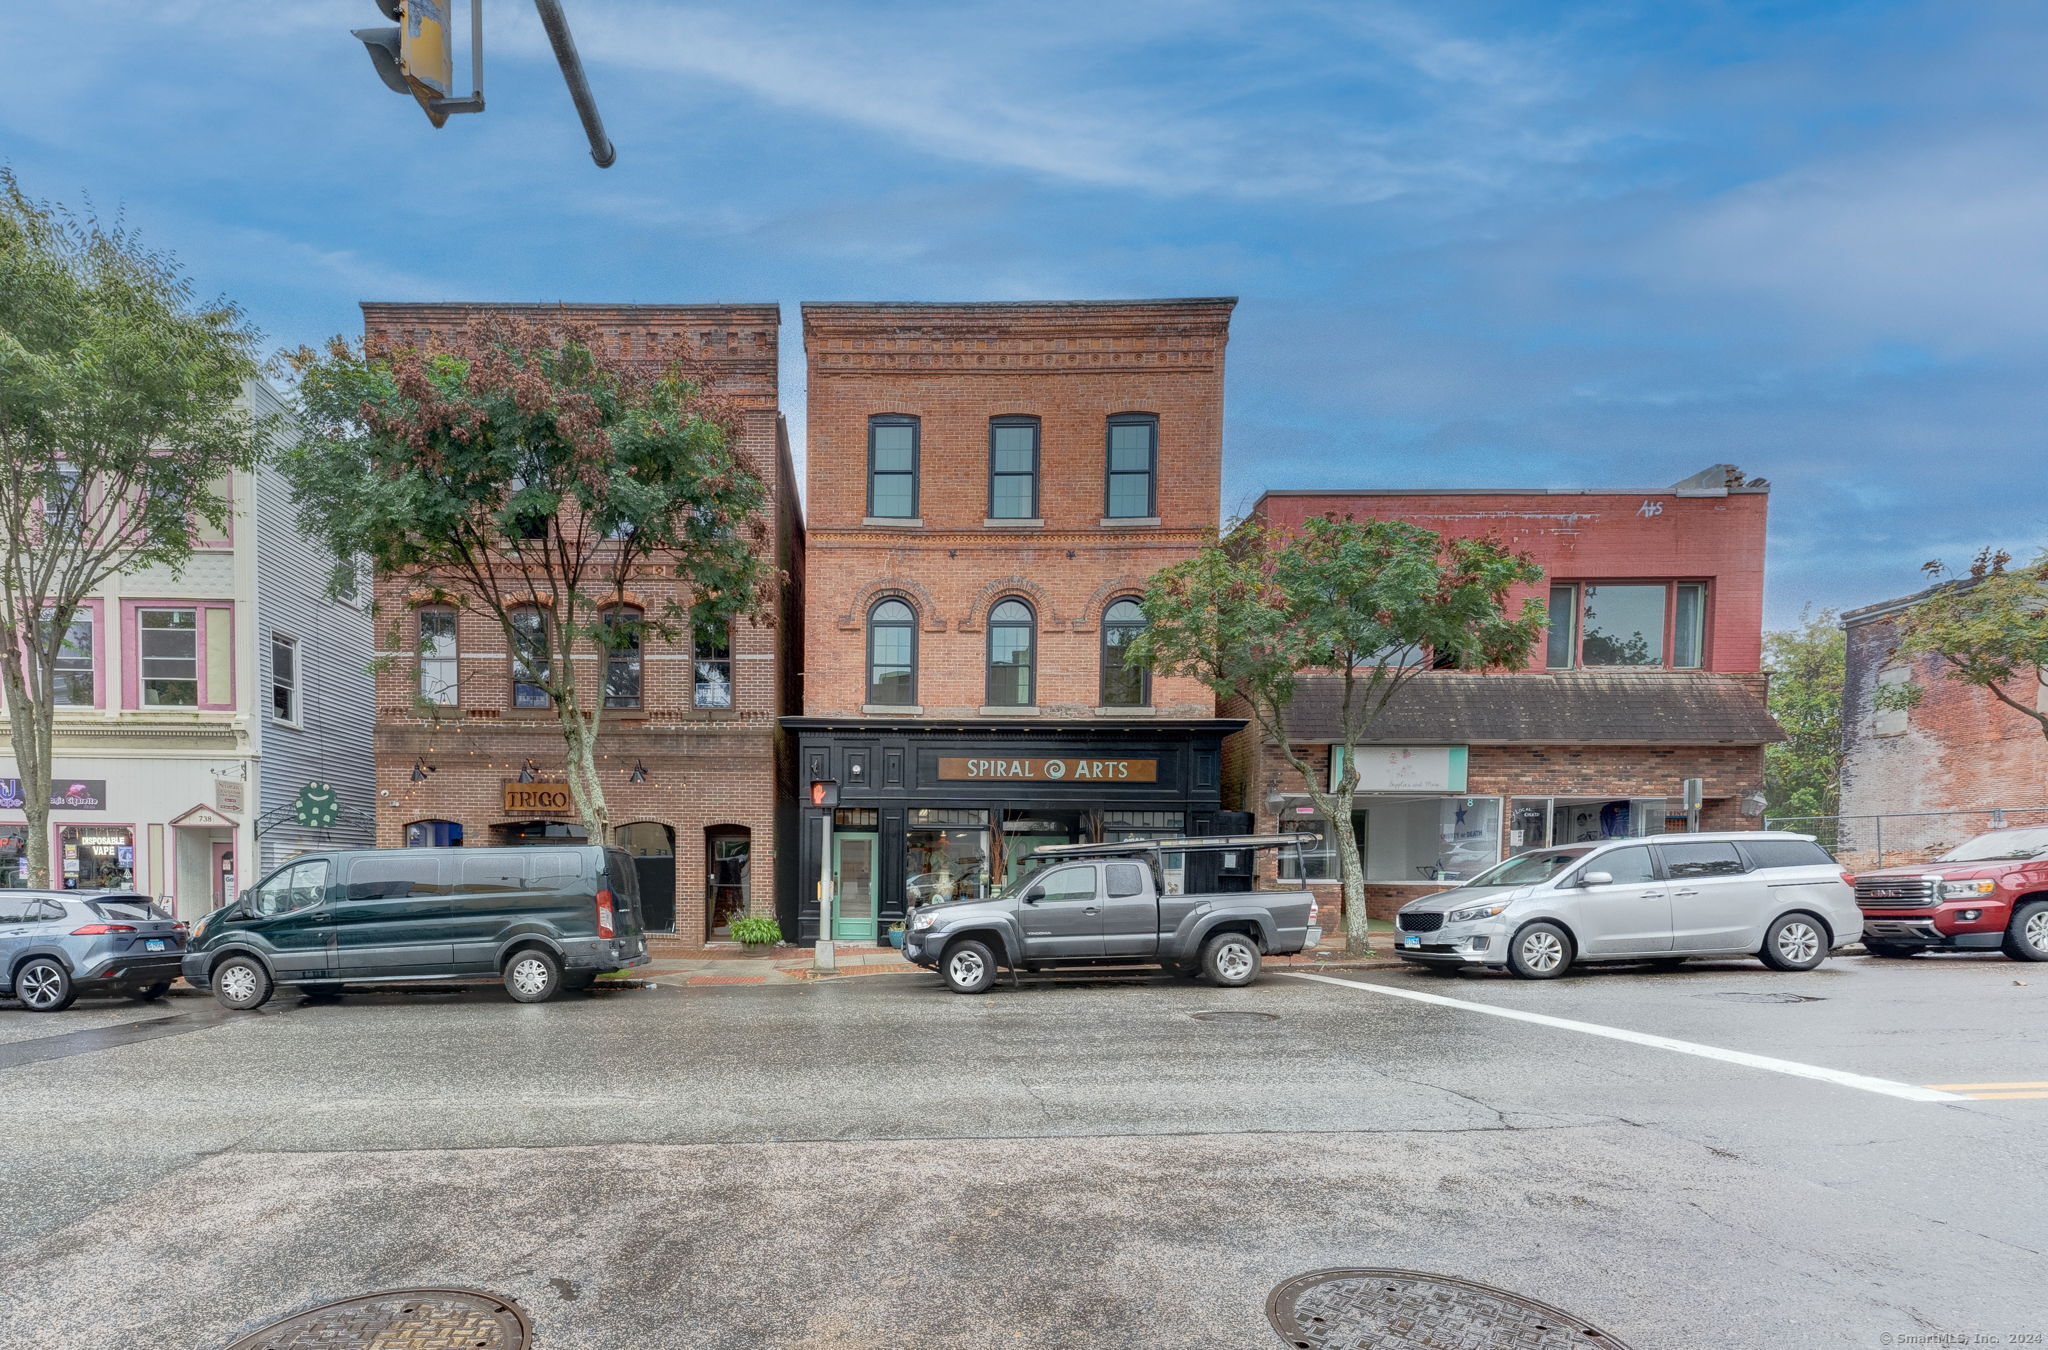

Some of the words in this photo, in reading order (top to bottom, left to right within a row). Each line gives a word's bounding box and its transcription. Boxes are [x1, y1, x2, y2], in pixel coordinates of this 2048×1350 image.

[967, 759, 1034, 777] SPIRAL
[1074, 760, 1128, 778] ARTS
[508, 791, 567, 807] TRIGO
[199, 815, 212, 823] 738
[1466, 830, 1483, 838] DEATH
[82, 836, 125, 846] DISPOSABLE
[92, 846, 115, 856] VAPE
